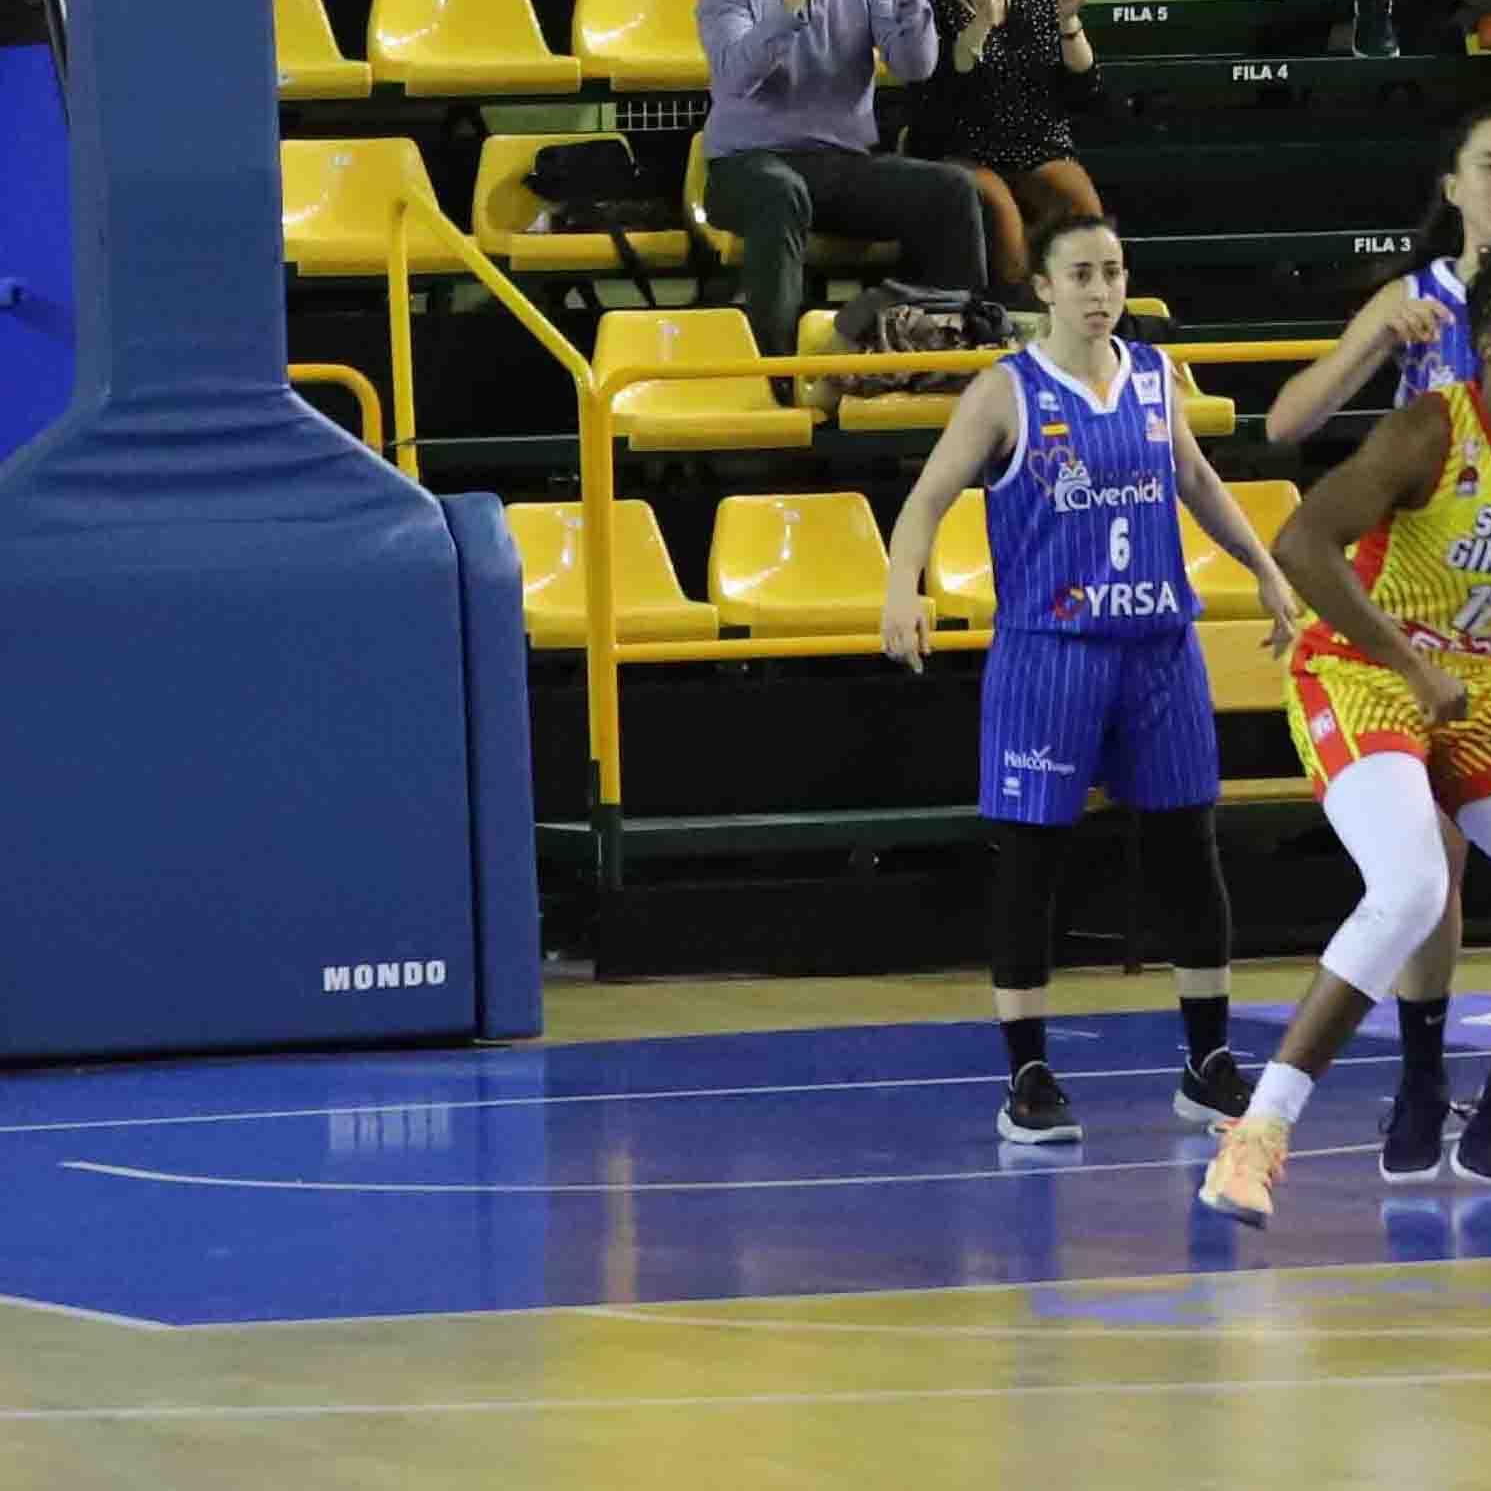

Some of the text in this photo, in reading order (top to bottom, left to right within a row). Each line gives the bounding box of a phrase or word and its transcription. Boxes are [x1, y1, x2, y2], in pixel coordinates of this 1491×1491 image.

[1112, 6, 1169, 22] FILA 5
[1231, 64, 1289, 80] FILA 4
[1354, 237, 1411, 252] FILA 3
[1109, 515, 1131, 572] 6
[323, 960, 447, 992] MONDO
